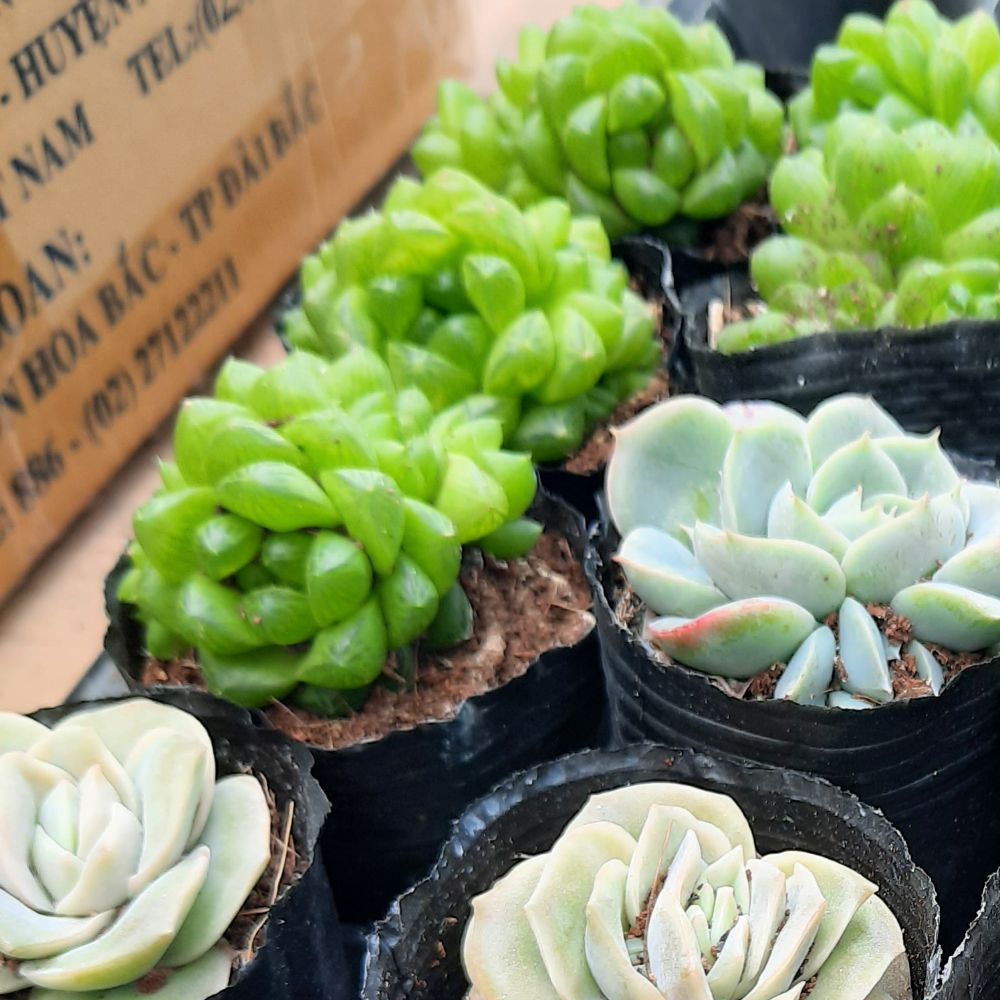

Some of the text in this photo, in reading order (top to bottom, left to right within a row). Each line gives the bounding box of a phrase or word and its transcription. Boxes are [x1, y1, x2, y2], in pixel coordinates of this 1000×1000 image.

[10, 102, 95, 200] NAM
[21, 314, 99, 399] HOA
[178, 186, 214, 243] TP
